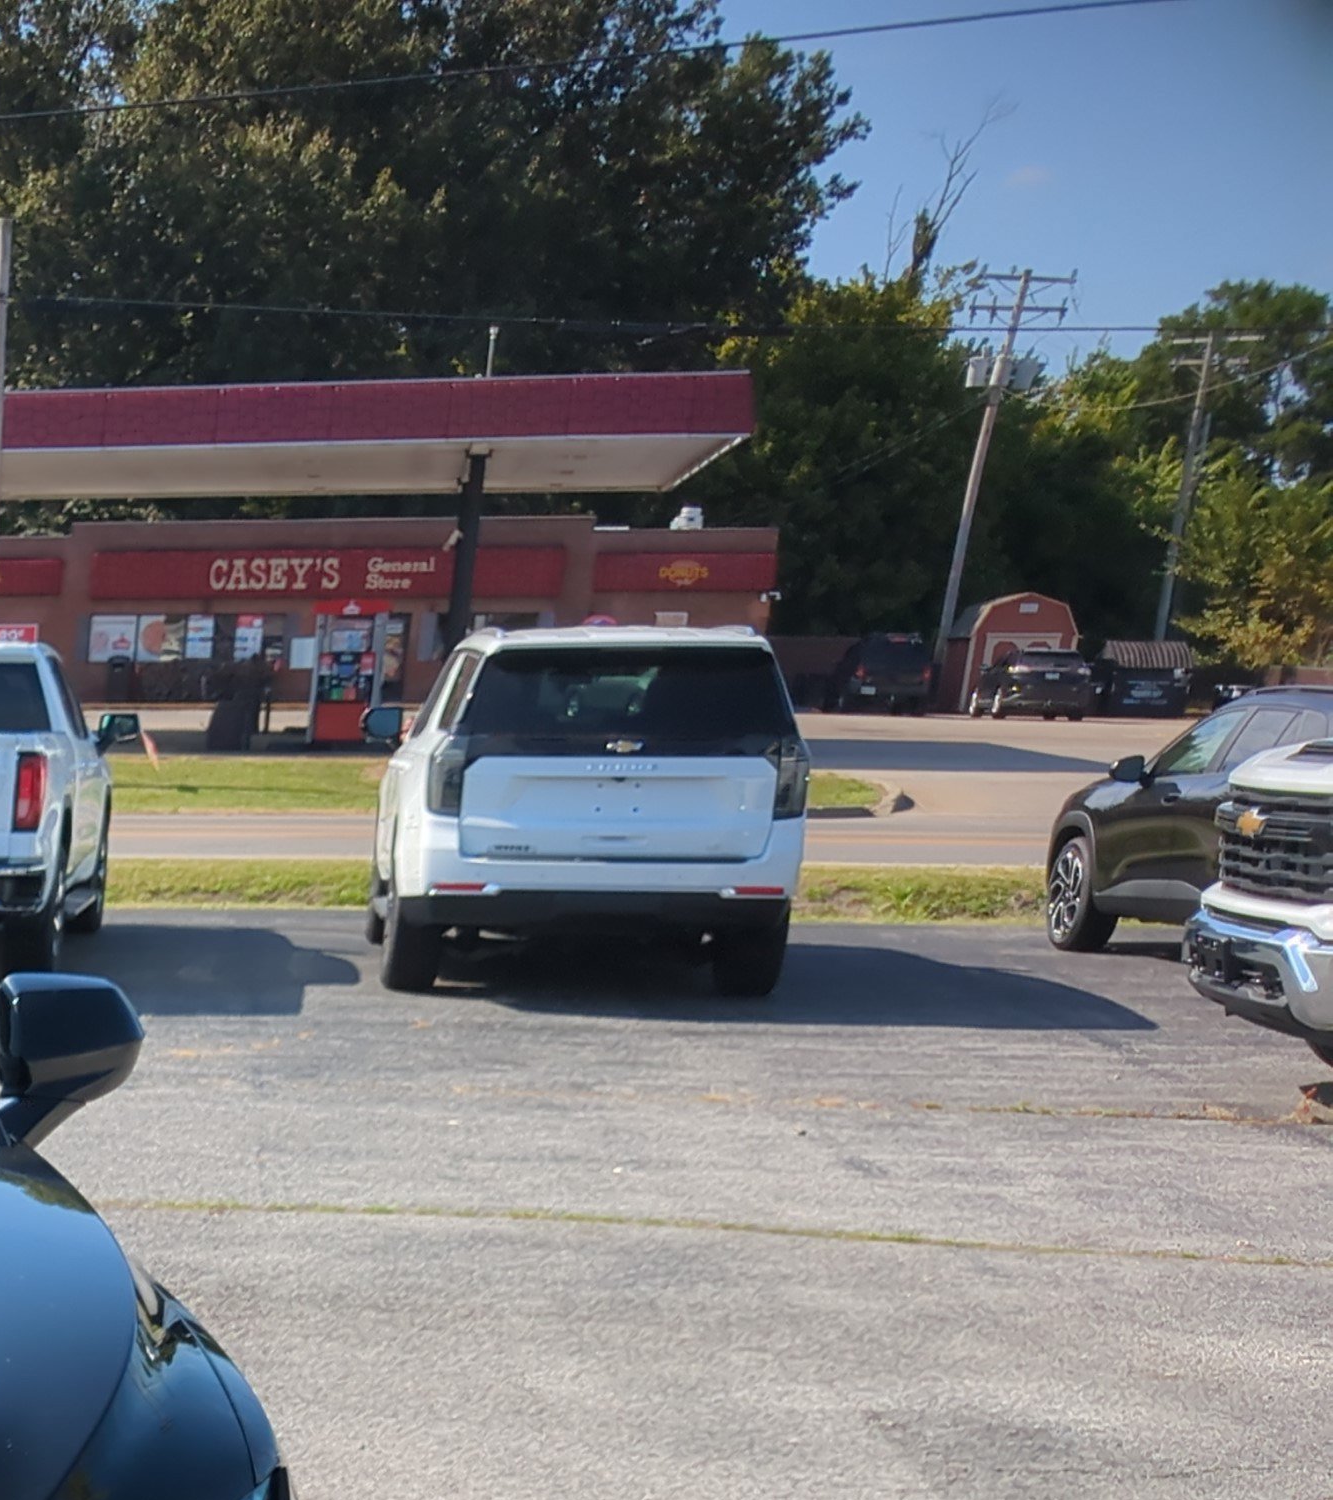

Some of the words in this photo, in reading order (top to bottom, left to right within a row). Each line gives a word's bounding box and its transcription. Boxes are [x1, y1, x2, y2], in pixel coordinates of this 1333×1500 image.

[209, 557, 340, 590] CASEY'S
[367, 557, 435, 573] General
[364, 573, 412, 590] Store
